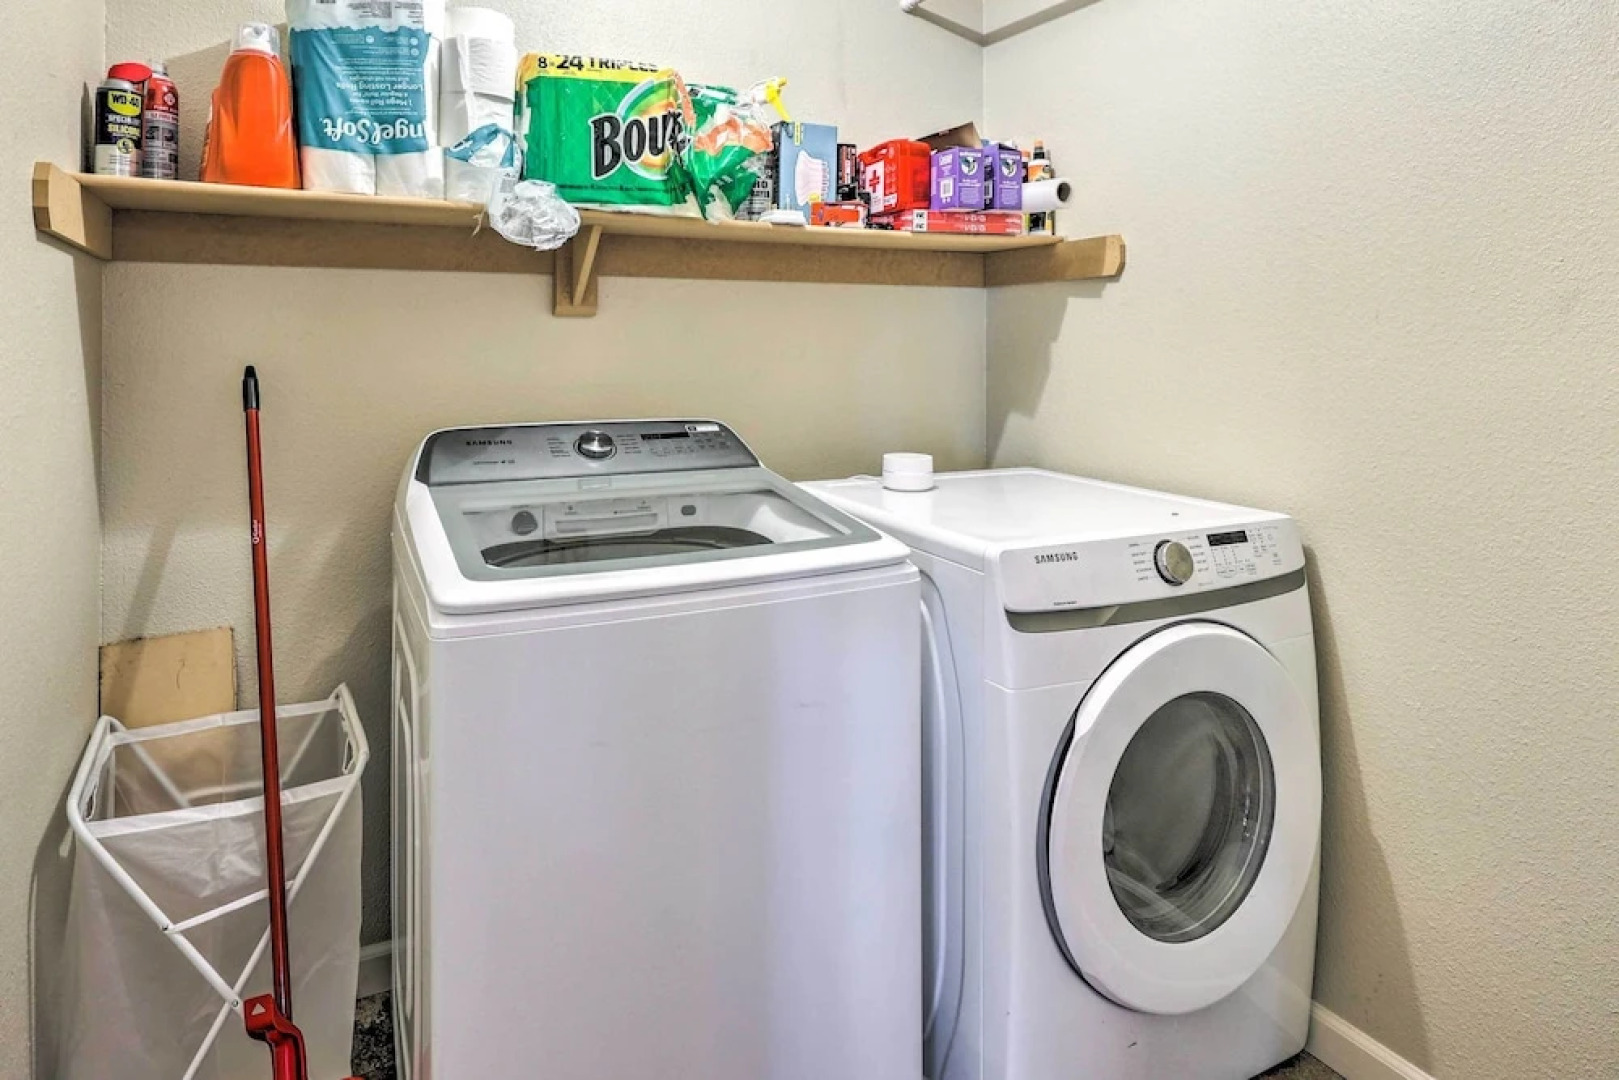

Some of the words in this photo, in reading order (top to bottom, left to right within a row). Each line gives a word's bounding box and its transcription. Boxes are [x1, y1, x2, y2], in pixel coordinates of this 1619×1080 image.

[538, 56, 548, 69] 8
[555, 54, 585, 71] 24
[359, 81, 391, 92] Lasting
[394, 82, 424, 92] Longer
[1034, 551, 1079, 564] SAMSUNG
